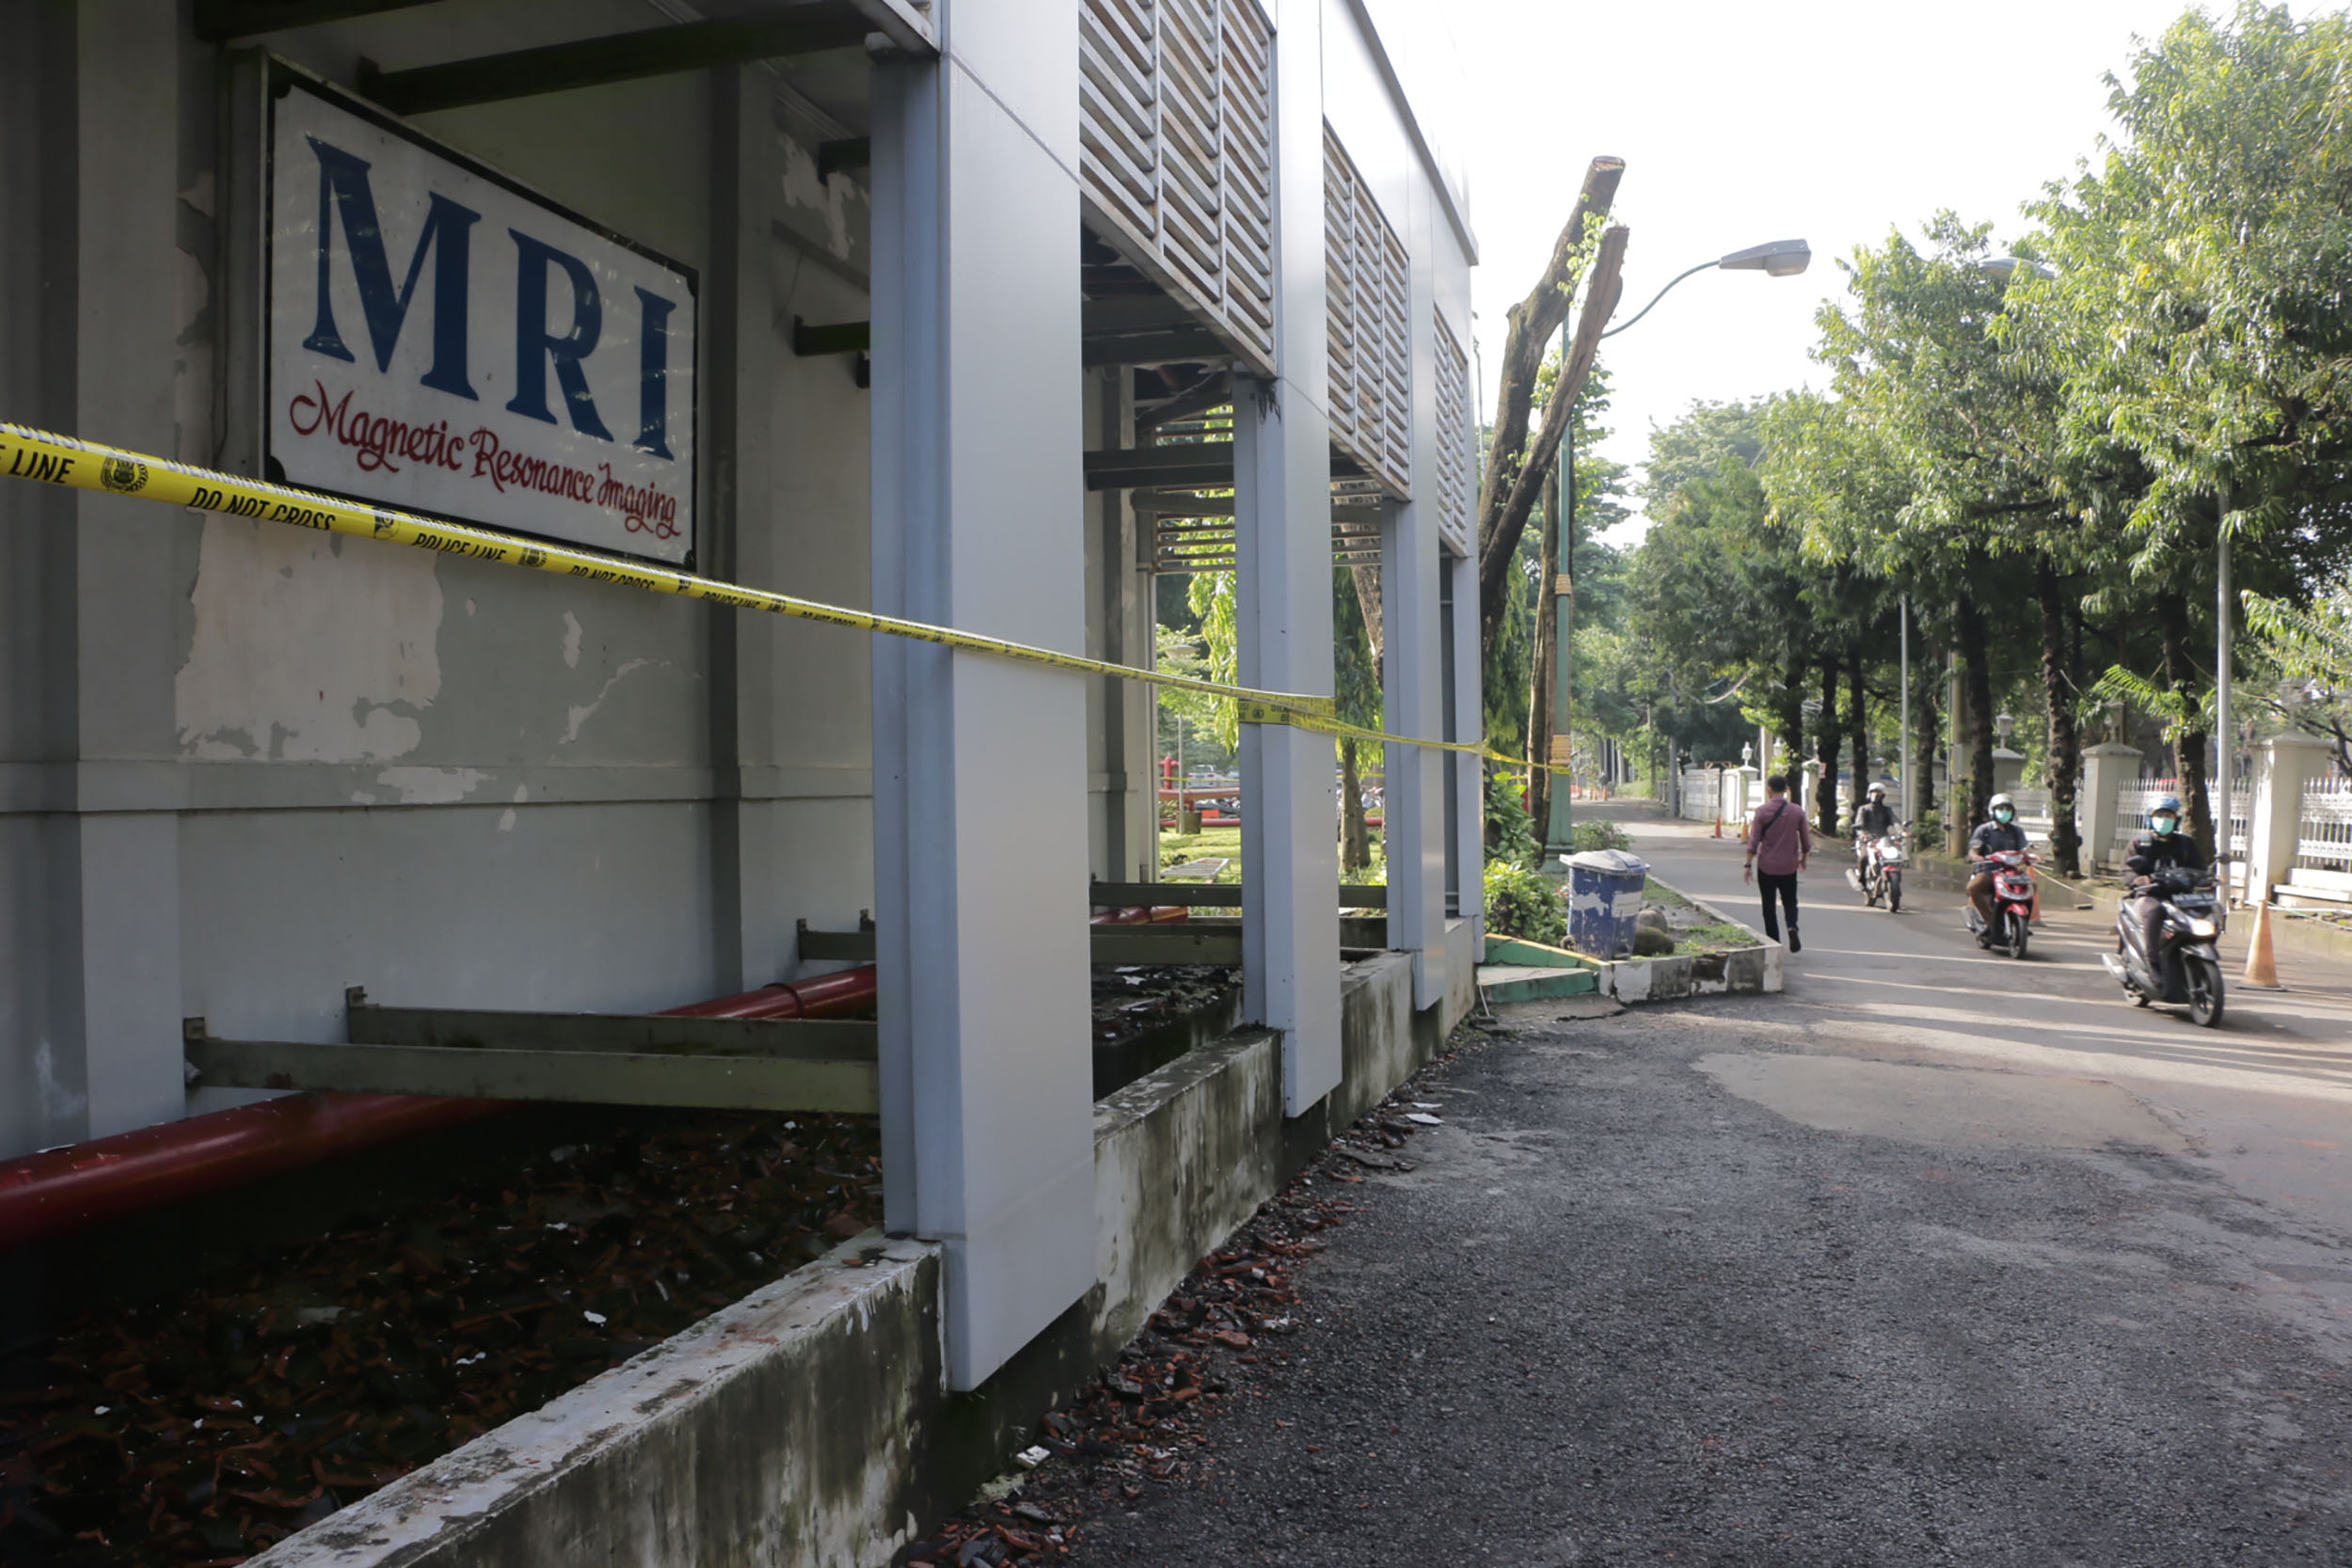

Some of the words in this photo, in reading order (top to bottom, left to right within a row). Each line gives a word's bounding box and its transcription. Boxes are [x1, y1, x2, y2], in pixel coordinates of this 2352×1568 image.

[303, 134, 676, 461] MRI
[8, 449, 75, 483] LINE
[189, 486, 222, 510] DO
[224, 494, 271, 516] NOT
[268, 503, 336, 531] CROSS
[290, 378, 465, 473] Magnetic
[469, 426, 595, 504] Resonance
[597, 462, 681, 540] Imaging
